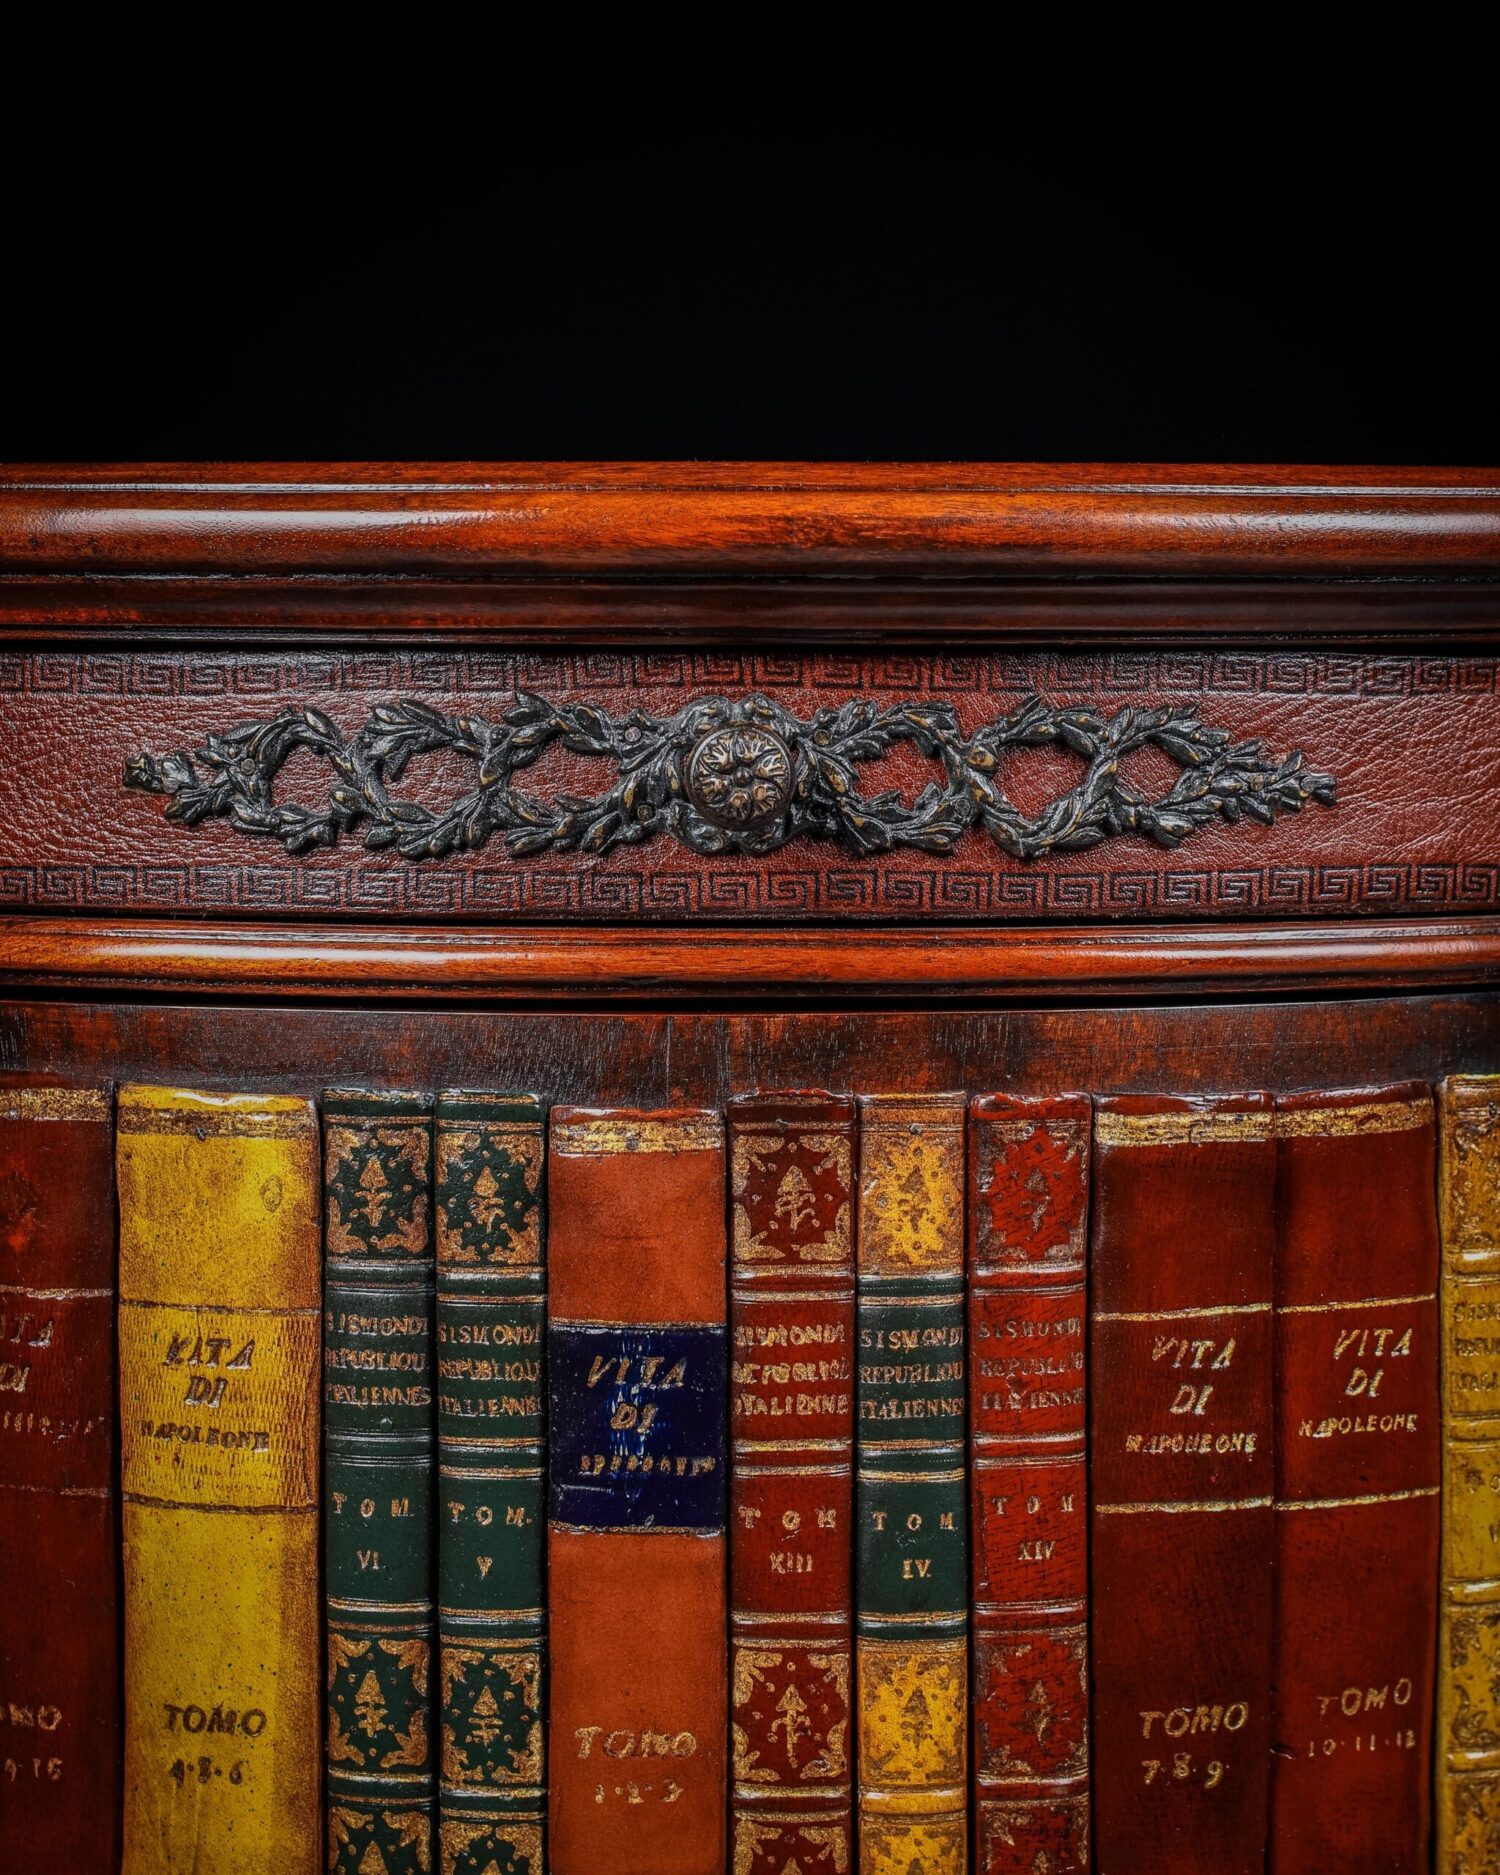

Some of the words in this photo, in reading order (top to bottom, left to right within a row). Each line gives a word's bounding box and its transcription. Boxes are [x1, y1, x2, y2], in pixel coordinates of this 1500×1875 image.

[438, 1321, 541, 1346] SISMONDI
[859, 1326, 964, 1351] SISMONDI
[1333, 1327, 1413, 1362] VITA
[1151, 1335, 1236, 1370] VITA
[587, 1354, 688, 1390] VITA
[1343, 1367, 1386, 1398] DI
[184, 1375, 229, 1409] DI
[1168, 1384, 1214, 1417] DI
[609, 1402, 659, 1435] DI
[1298, 1413, 1418, 1440] NAPOLEONE
[139, 1419, 271, 1454] NAPOLEONE
[1125, 1431, 1258, 1457] NAPOLEONE
[991, 1494, 1075, 1516] TOM
[1017, 1539, 1056, 1561] XIV
[1316, 1677, 1413, 1720] TOMO
[163, 1702, 268, 1738] TOMO
[1139, 1701, 1249, 1739] TOMO
[573, 1726, 697, 1759] TOMO
